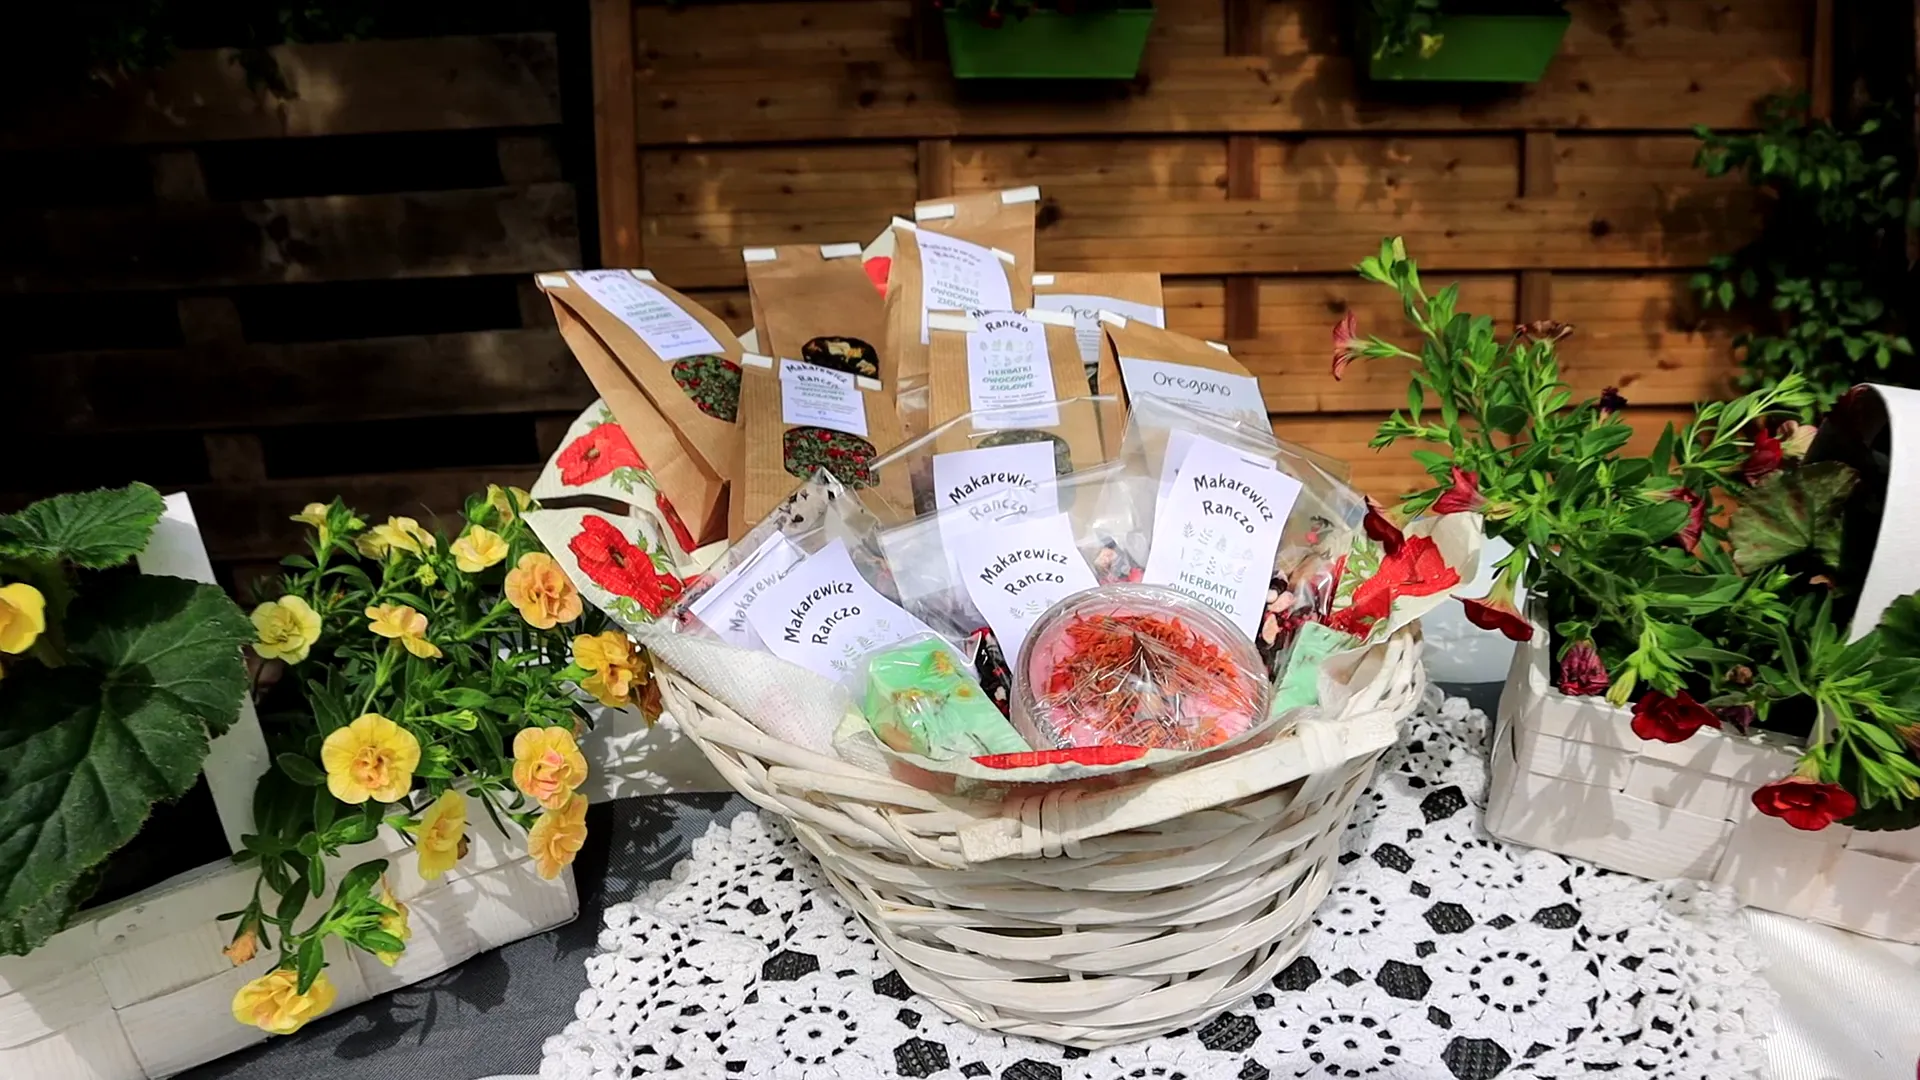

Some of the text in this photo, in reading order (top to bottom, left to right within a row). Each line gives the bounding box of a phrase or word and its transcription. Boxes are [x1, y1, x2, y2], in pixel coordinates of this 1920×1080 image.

[985, 320, 1028, 333] Ranczo
[1153, 371, 1231, 397] Oregano
[949, 471, 1040, 505] Makarewicz
[1193, 473, 1274, 523] Makarewicz
[968, 498, 1029, 522] Ranczo
[1202, 500, 1255, 534] Ranczo
[979, 547, 1068, 586] Makarewicz
[1004, 571, 1065, 596] Ranczo
[1179, 571, 1238, 600] HERBATKI
[784, 580, 854, 644] Makarewicz
[812, 604, 861, 645] Ranczo
